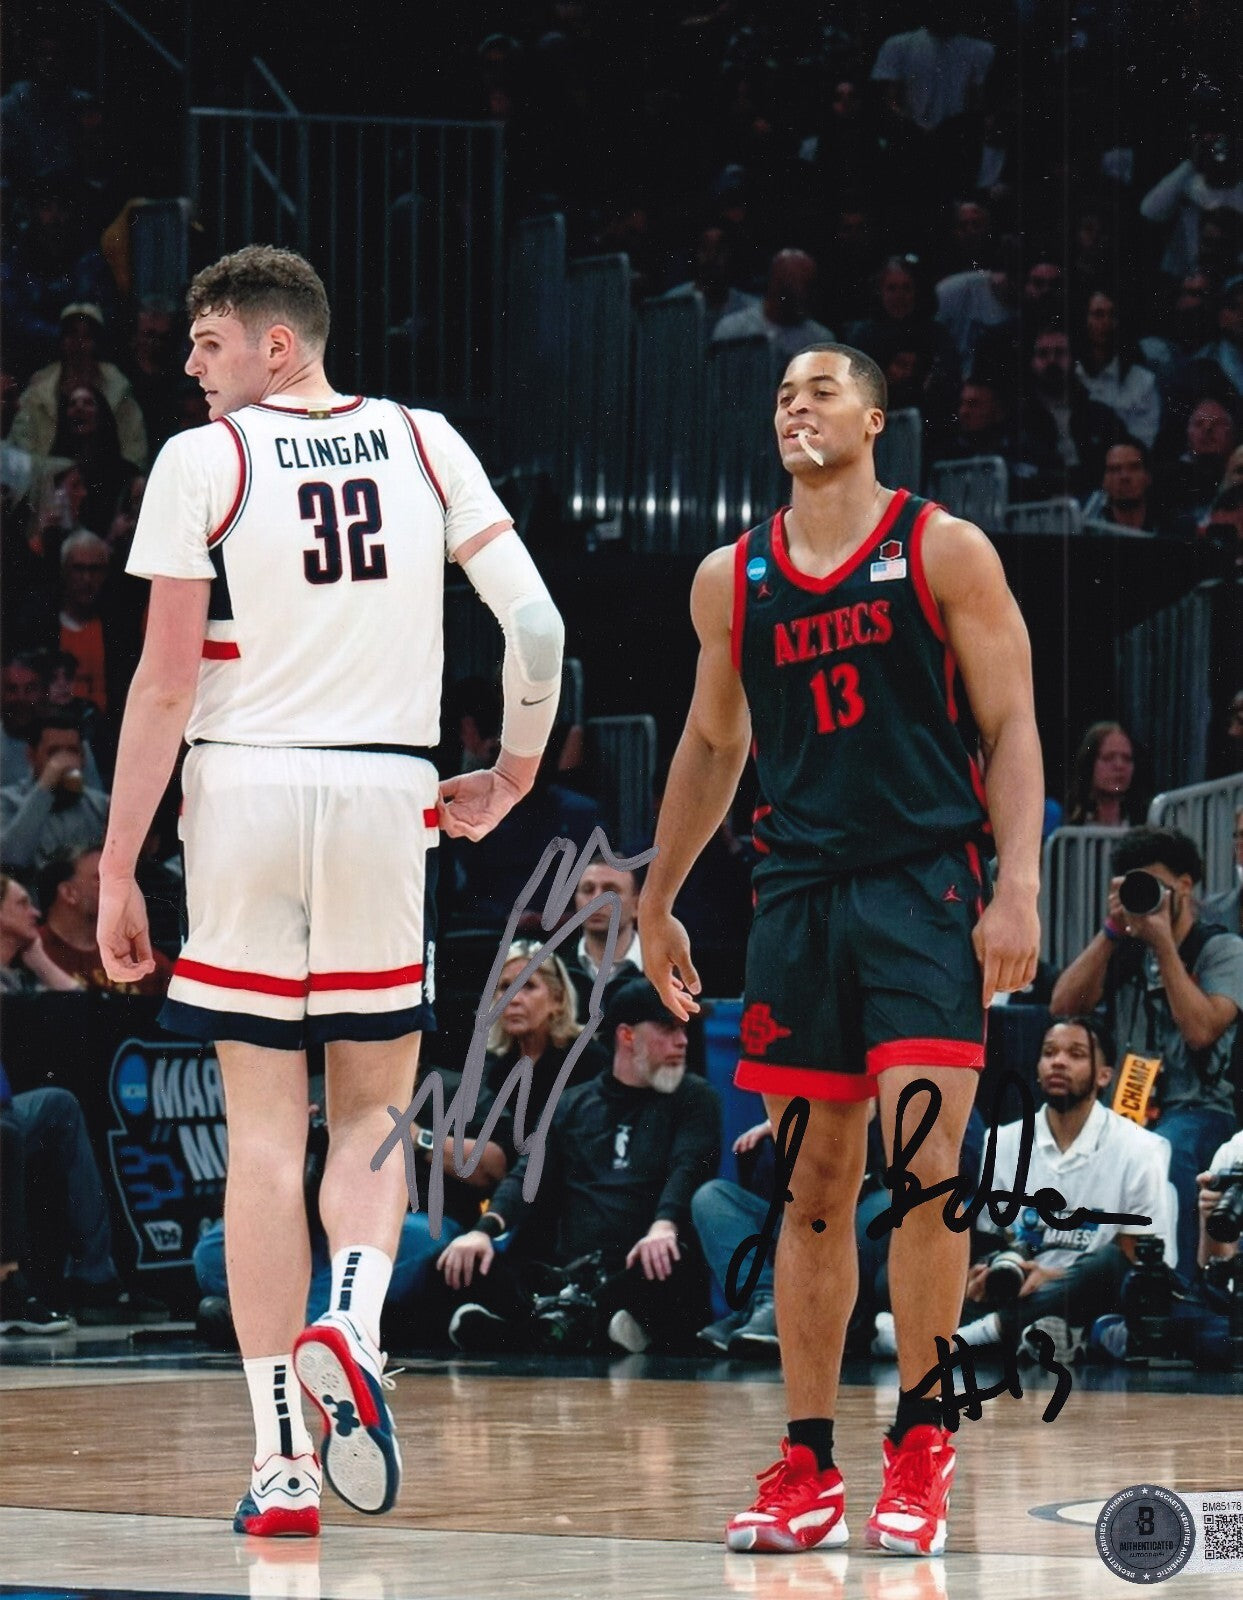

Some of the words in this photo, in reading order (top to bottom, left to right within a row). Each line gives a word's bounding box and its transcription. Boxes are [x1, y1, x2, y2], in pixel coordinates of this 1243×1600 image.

[274, 429, 389, 469] CLINGAN
[297, 477, 388, 585] 32
[774, 599, 893, 668] AZTECS
[809, 661, 866, 735] 13
[152, 1058, 227, 1119] MAR
[1120, 1059, 1151, 1111] CHAMP
[1103, 1490, 1134, 1522] AUTHENTIC
[1154, 1489, 1183, 1512] BECKETT
[1120, 1540, 1174, 1551] AUTHENTICATED
[1179, 1511, 1191, 1548] VERIFIED
[1107, 1556, 1136, 1578] BECKETT
[1156, 1547, 1188, 1578] AUTHENTIC
